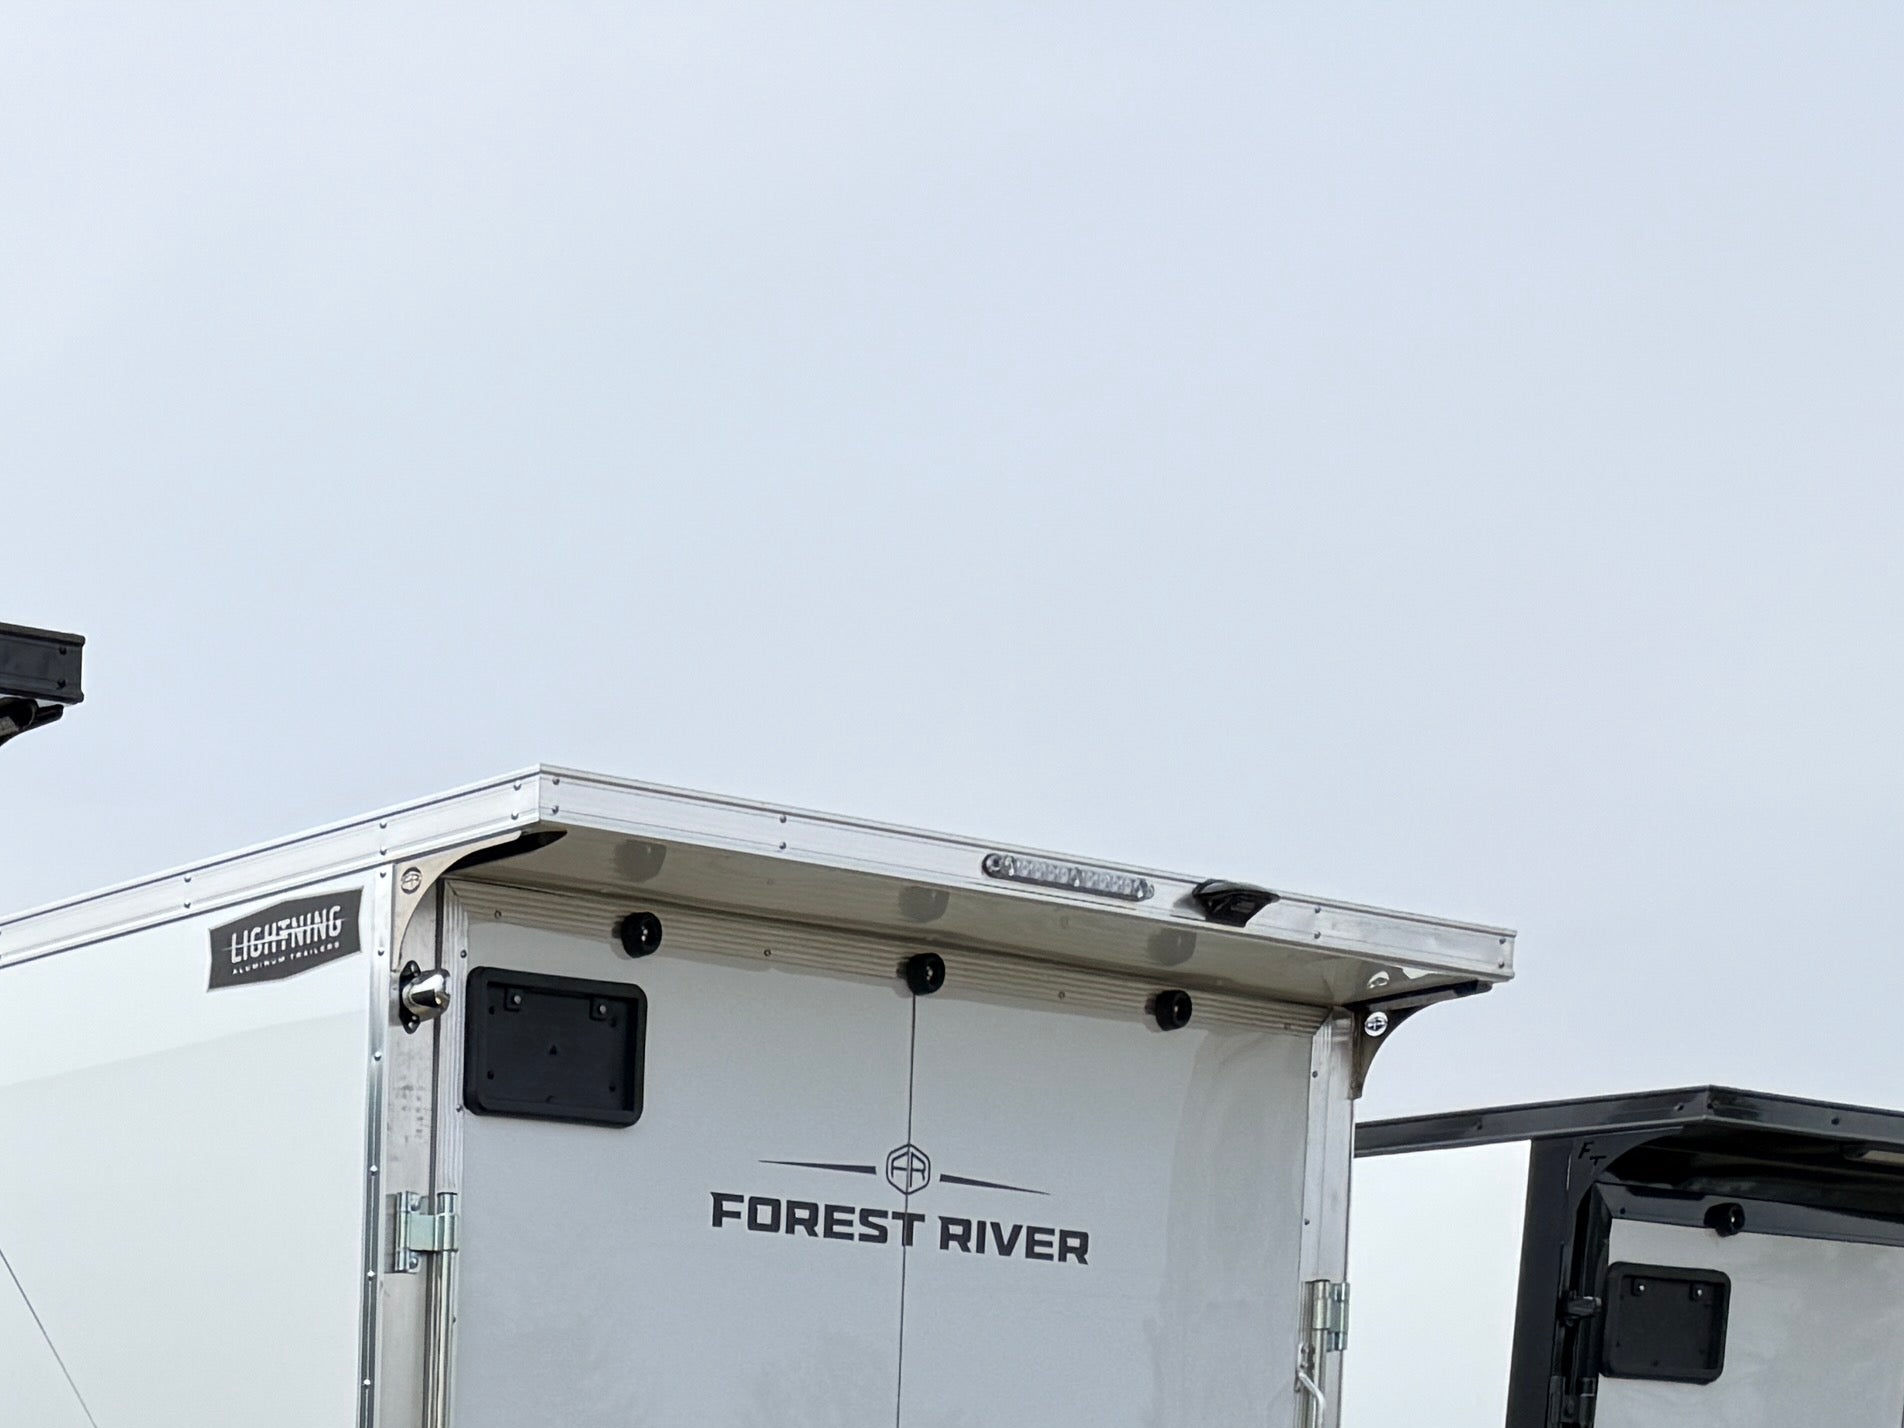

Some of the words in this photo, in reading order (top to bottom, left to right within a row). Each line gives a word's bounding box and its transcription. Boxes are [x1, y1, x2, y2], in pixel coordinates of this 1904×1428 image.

[230, 905, 343, 964] LIGHTNING
[231, 956, 286, 975] ALUMINUM
[290, 941, 341, 960] TRAILERS
[709, 1191, 926, 1248] FOREST
[938, 1215, 1089, 1265] RIVER
